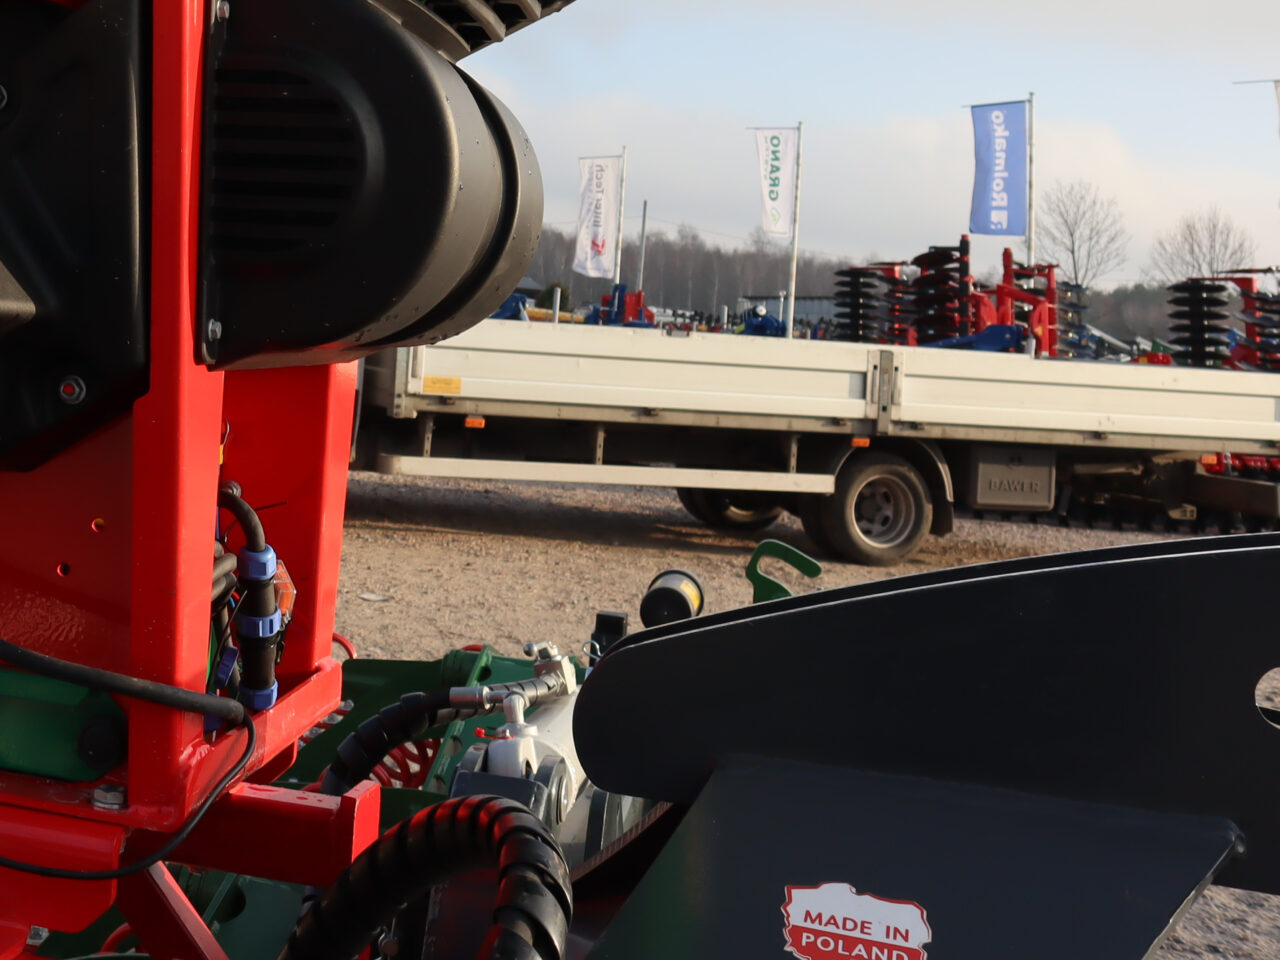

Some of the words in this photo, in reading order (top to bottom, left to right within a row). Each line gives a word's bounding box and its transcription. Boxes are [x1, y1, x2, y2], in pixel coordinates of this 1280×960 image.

[803, 910, 872, 935] MADE
[885, 925, 910, 943] IN
[801, 932, 909, 960] POLAND
